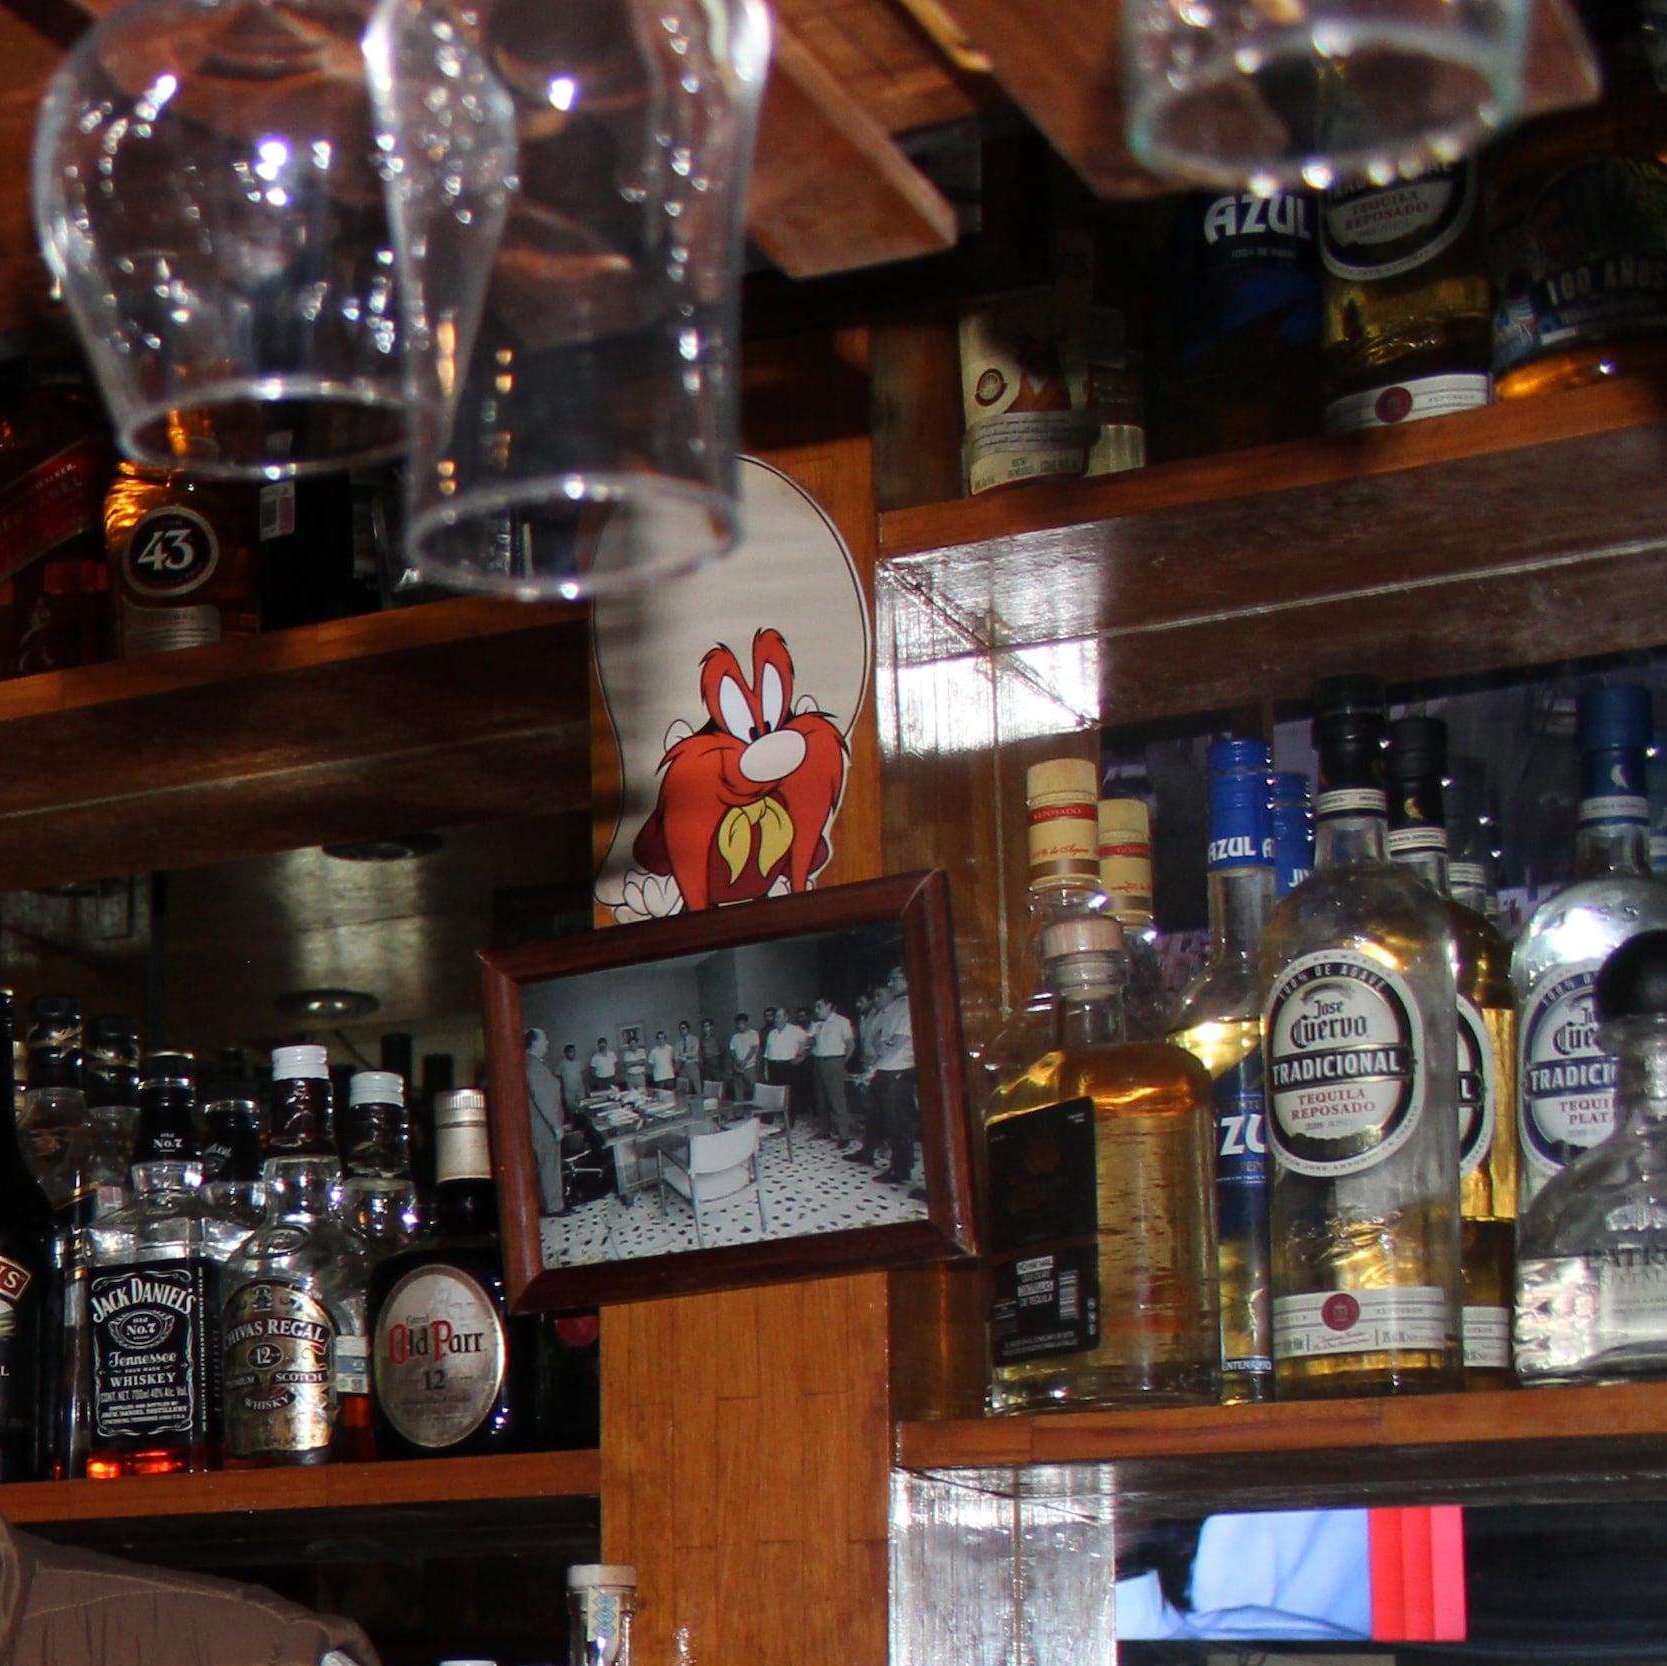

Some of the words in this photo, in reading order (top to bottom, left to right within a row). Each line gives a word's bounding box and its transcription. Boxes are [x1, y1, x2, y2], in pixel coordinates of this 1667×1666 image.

[1203, 195, 1313, 246] AZUL
[1344, 201, 1430, 232] REPOSADO
[137, 528, 195, 571] 43
[1289, 1015, 1369, 1050] Cuervo
[1552, 1021, 1596, 1056] Cue
[1271, 1050, 1402, 1086] TRADICIONAL
[1297, 1088, 1366, 1106] TEQUILA
[1559, 1098, 1612, 1113] TEQUI
[1290, 1101, 1376, 1122] REPOSADO
[1569, 1112, 1613, 1125] PLAT
[152, 1137, 184, 1150] No.7
[90, 1286, 132, 1324] JACK
[130, 1277, 197, 1315] DANIEL'S
[125, 1322, 157, 1337] No.7
[267, 1318, 327, 1343] REGAL
[388, 1323, 429, 1365] Old
[429, 1319, 484, 1362] Parr
[108, 1351, 177, 1367] Tennessee
[255, 1345, 272, 1365] 12
[1221, 1358, 1273, 1372] ENTENARIO
[109, 1372, 177, 1388] WHISKEY
[274, 1372, 324, 1384] SCOTCH
[422, 1368, 446, 1391] 12
[244, 1394, 290, 1410] WHISKY
